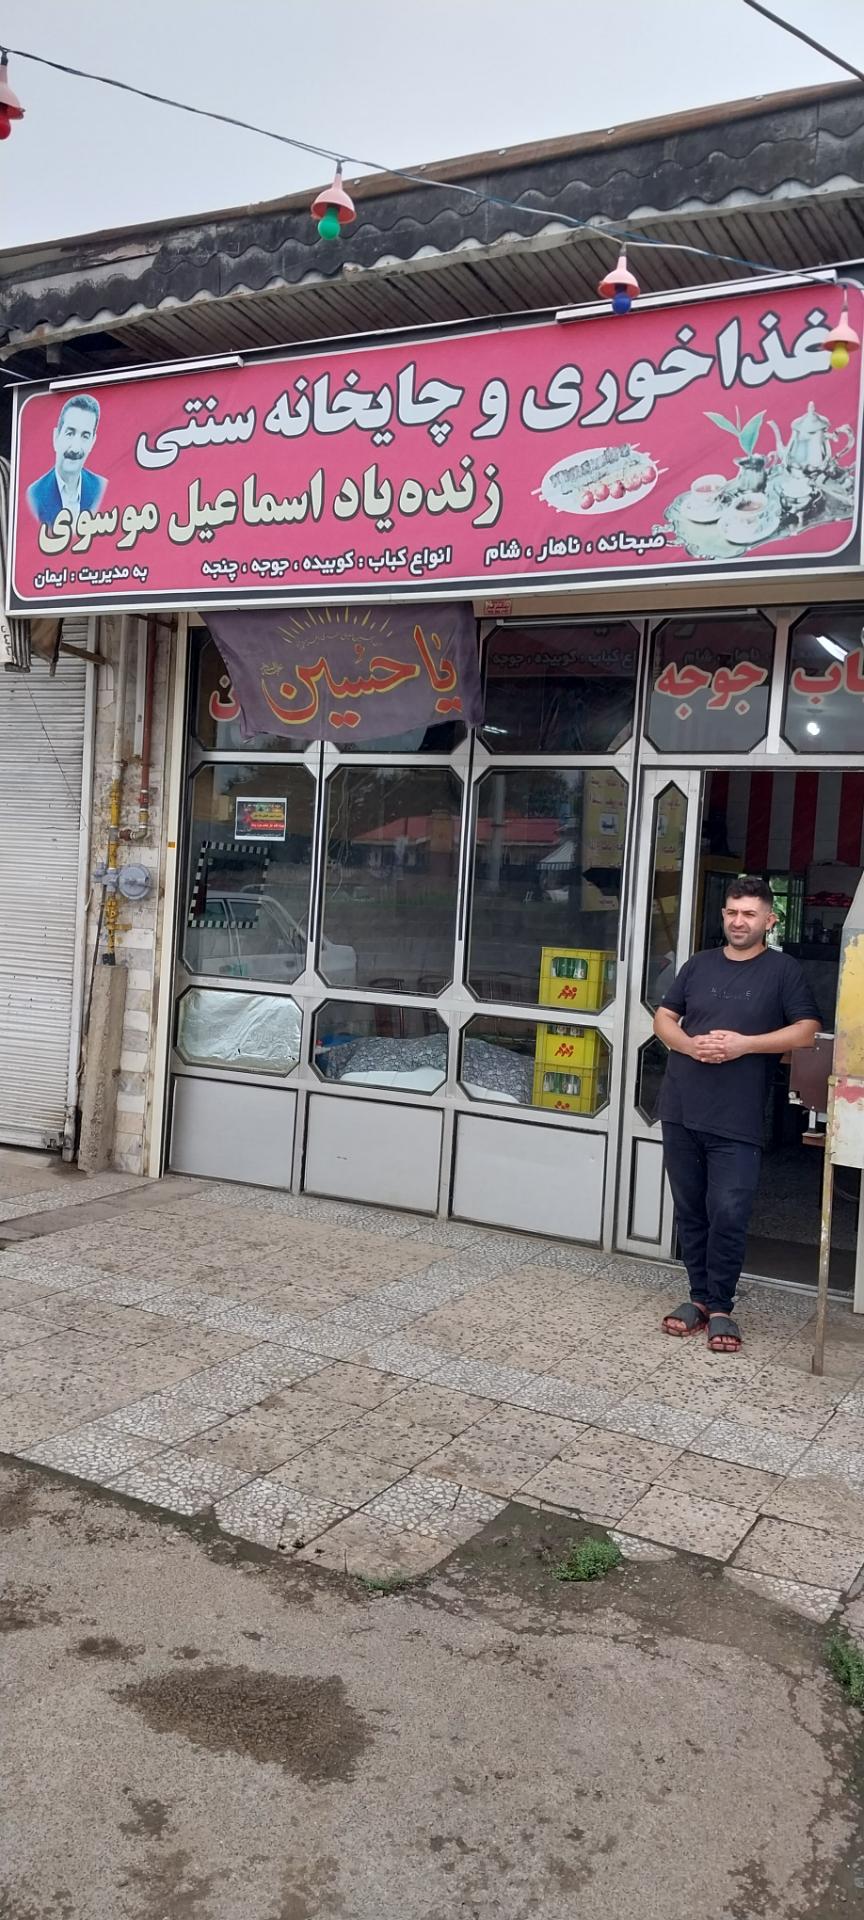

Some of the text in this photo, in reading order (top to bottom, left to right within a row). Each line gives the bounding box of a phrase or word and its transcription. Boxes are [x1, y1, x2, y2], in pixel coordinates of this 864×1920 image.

[135, 308, 838, 469] غذاخوری و چایخانه سنتی
[38, 454, 504, 554] زنده یاد اسماعیل موسوی
[484, 539, 521, 567] شام
[536, 535, 581, 562] ناهار
[597, 531, 667, 556] صبحانه
[201, 559, 239, 582] چنجه
[250, 557, 291, 577] جوجه
[301, 549, 355, 575] کوبیده
[367, 546, 408, 573] کباب
[409, 545, 453, 577] انواع
[33, 567, 68, 589] ایمان
[78, 565, 130, 585] مدیریت
[132, 564, 149, 583] به
[654, 660, 768, 720] جوجه
